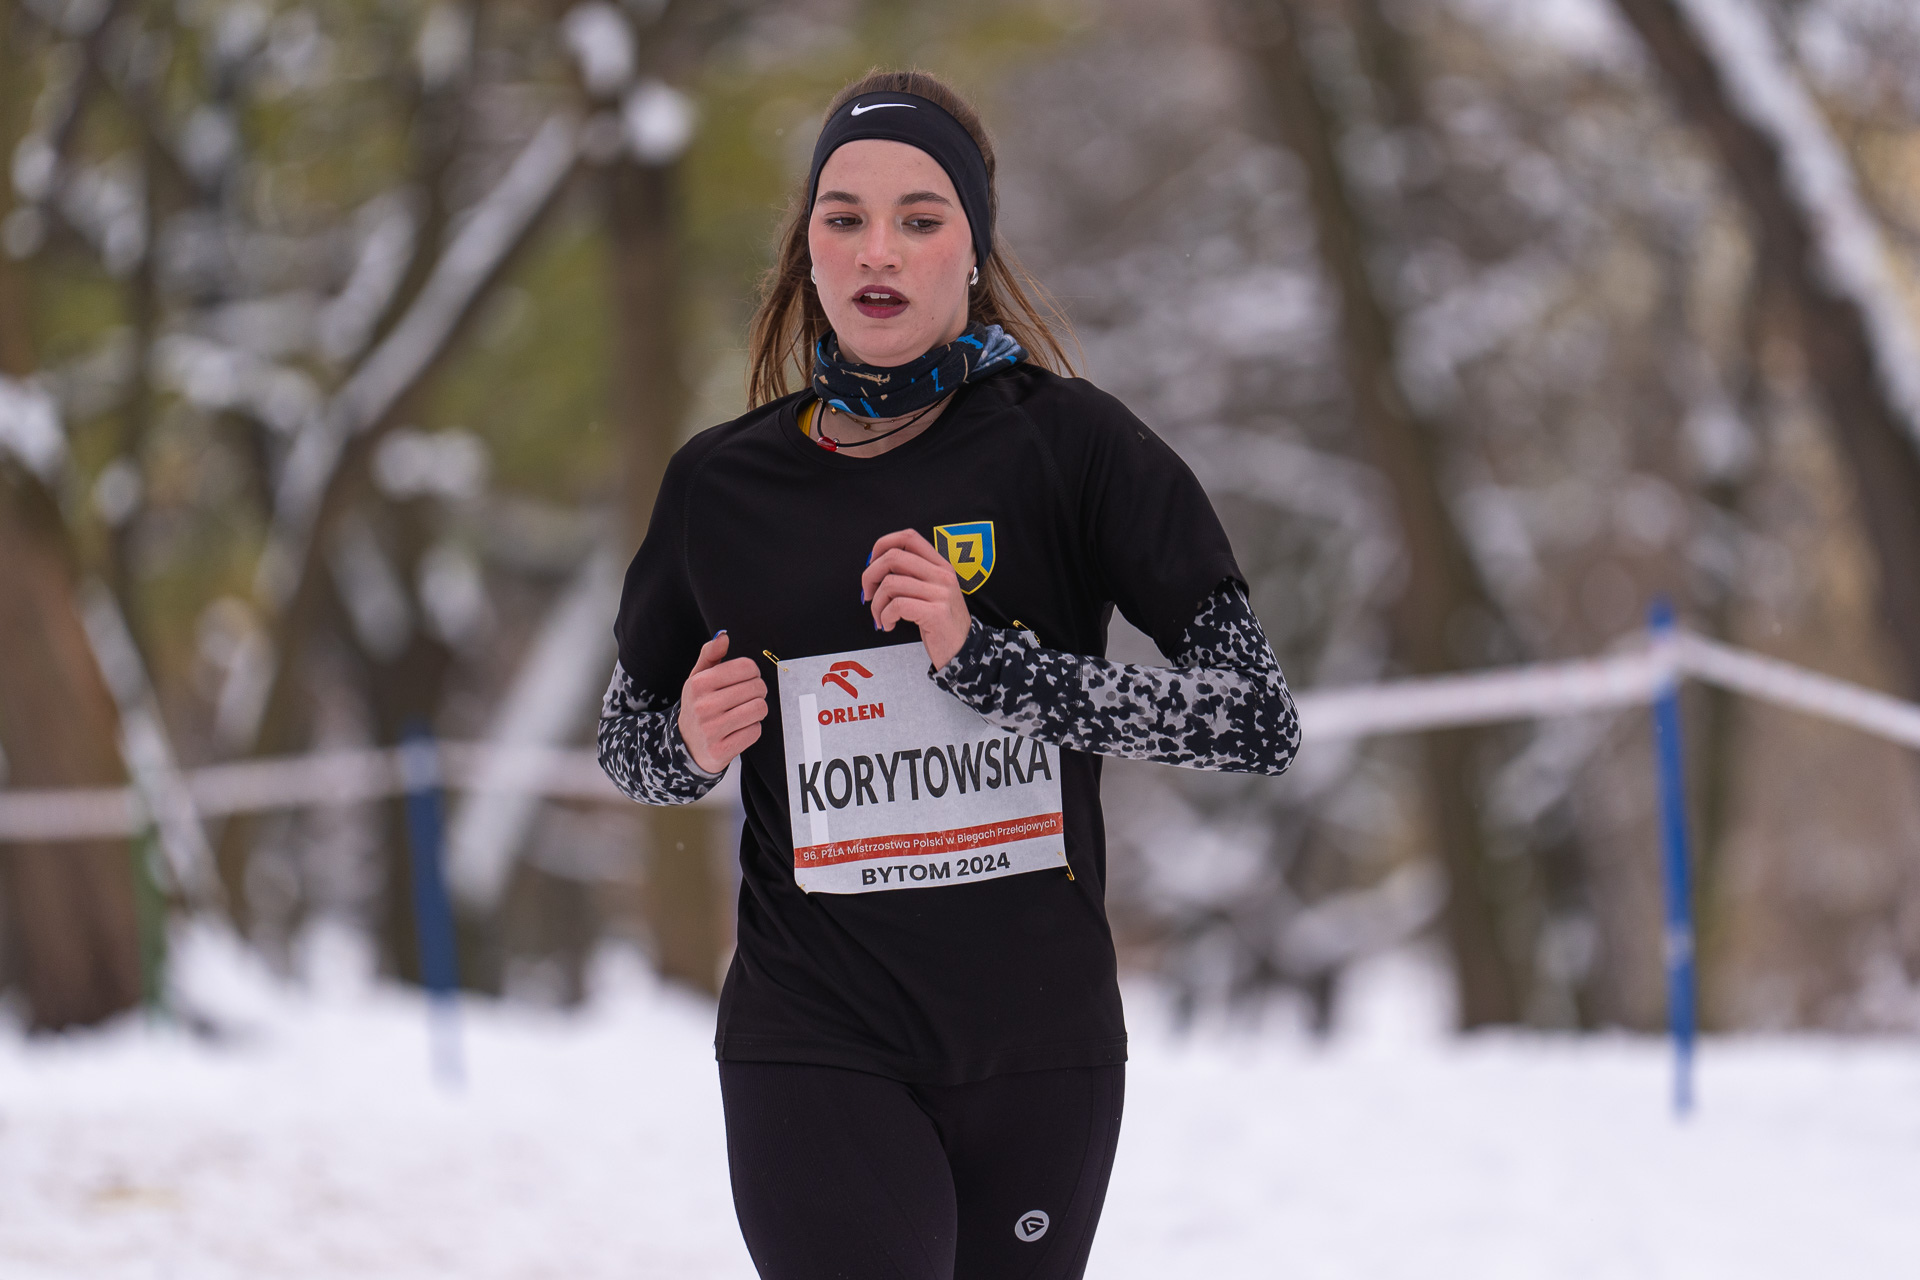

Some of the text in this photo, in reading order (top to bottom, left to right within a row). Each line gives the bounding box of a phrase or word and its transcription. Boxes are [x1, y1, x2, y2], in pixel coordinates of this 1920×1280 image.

[956, 541, 975, 563] Z
[817, 702, 885, 725] ORLEN
[798, 737, 1052, 814] KORYTOWSKA
[803, 851, 819, 861] 96.
[847, 840, 911, 855] Mistrzostwa
[913, 836, 943, 848] Polski
[945, 836, 955, 845] w
[957, 828, 996, 844] Biegach
[997, 819, 1056, 837] Przełajowych
[862, 852, 1011, 885] BYTOM 2024
